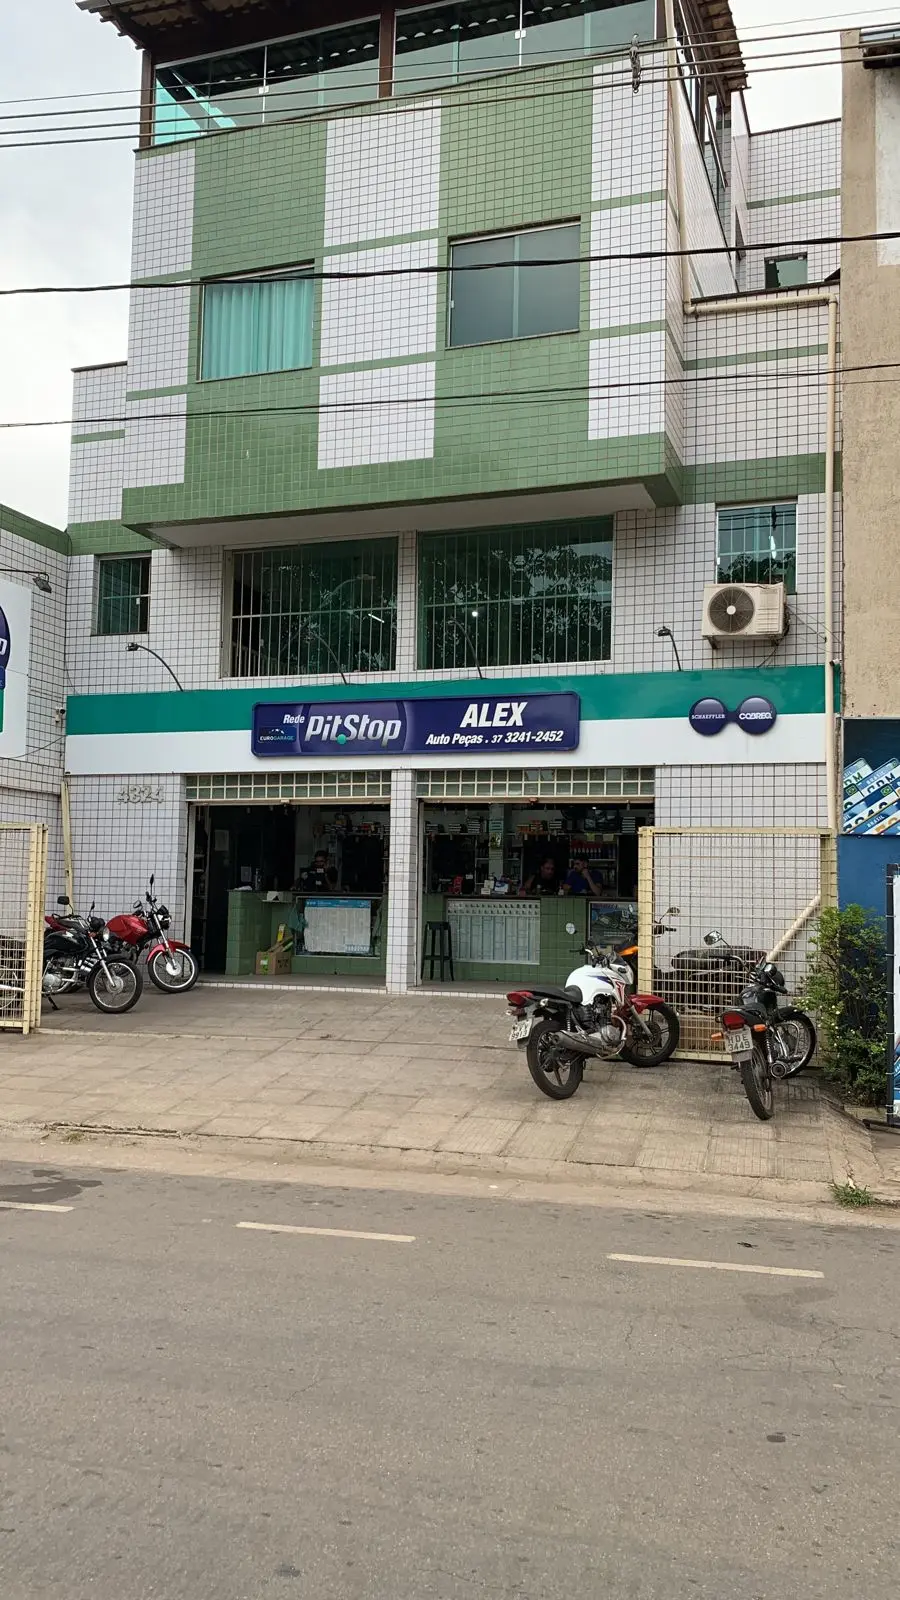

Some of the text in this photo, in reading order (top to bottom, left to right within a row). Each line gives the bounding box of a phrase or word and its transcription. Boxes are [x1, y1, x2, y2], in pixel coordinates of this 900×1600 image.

[283, 714, 305, 724] Rede
[460, 702, 528, 728] ALEX
[425, 733, 450, 745] Auto
[452, 733, 483, 747] Peças
[491, 735, 503, 744] 37
[504, 730, 564, 744] 3241-2452
